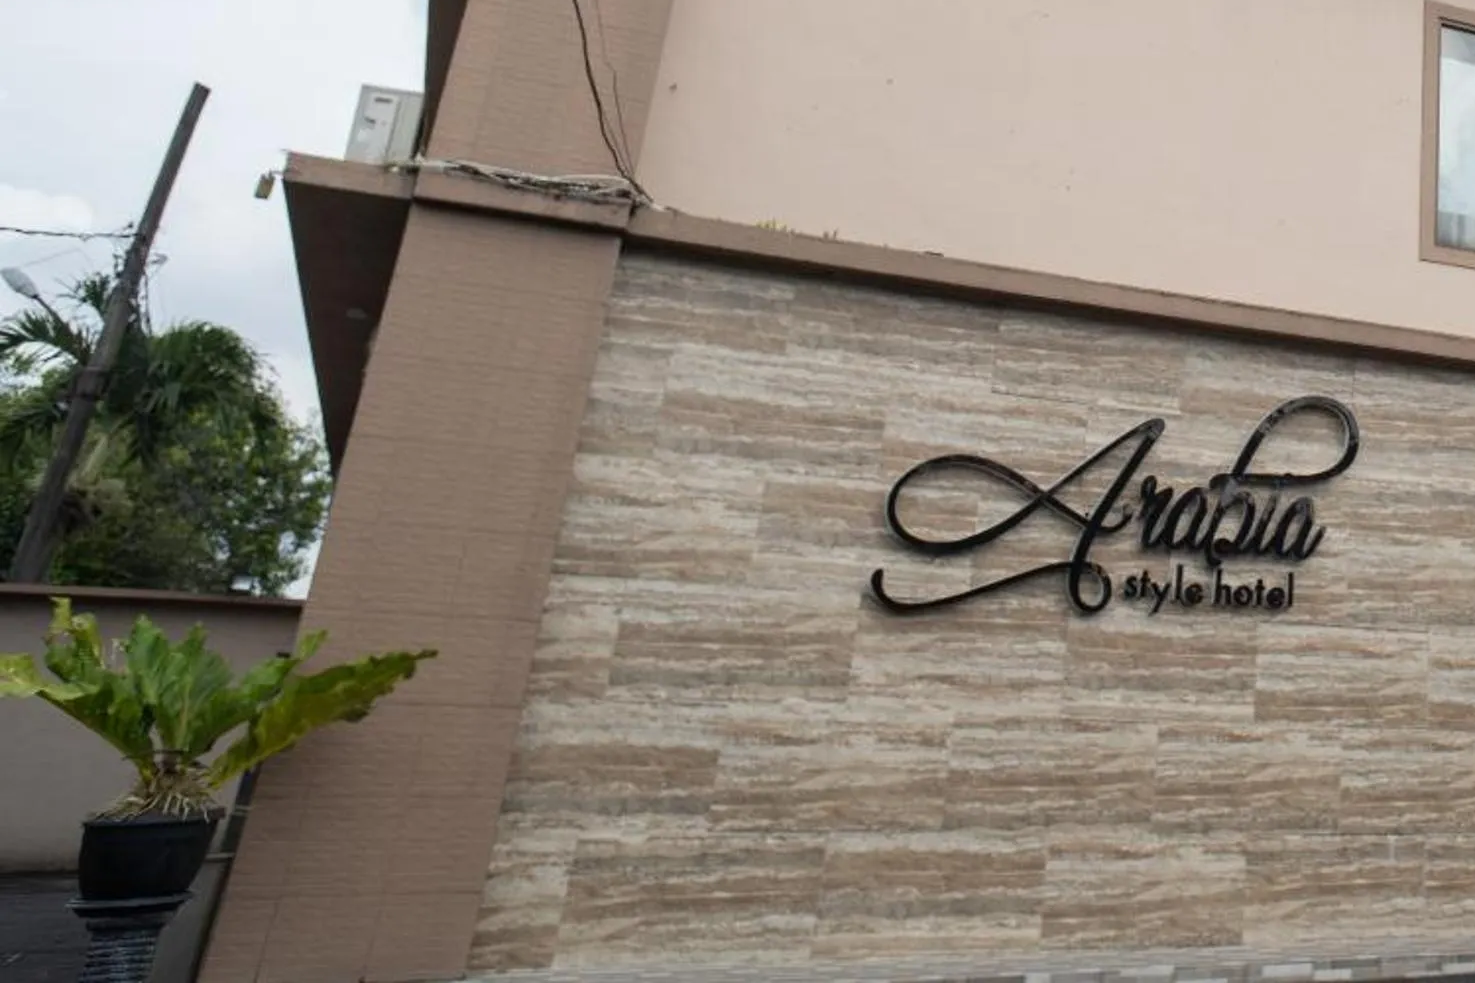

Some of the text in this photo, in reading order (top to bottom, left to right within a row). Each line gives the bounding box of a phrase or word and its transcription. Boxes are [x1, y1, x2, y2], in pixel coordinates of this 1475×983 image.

[870, 395, 1360, 613] Arabia
[1123, 564, 1295, 613] style hotel
